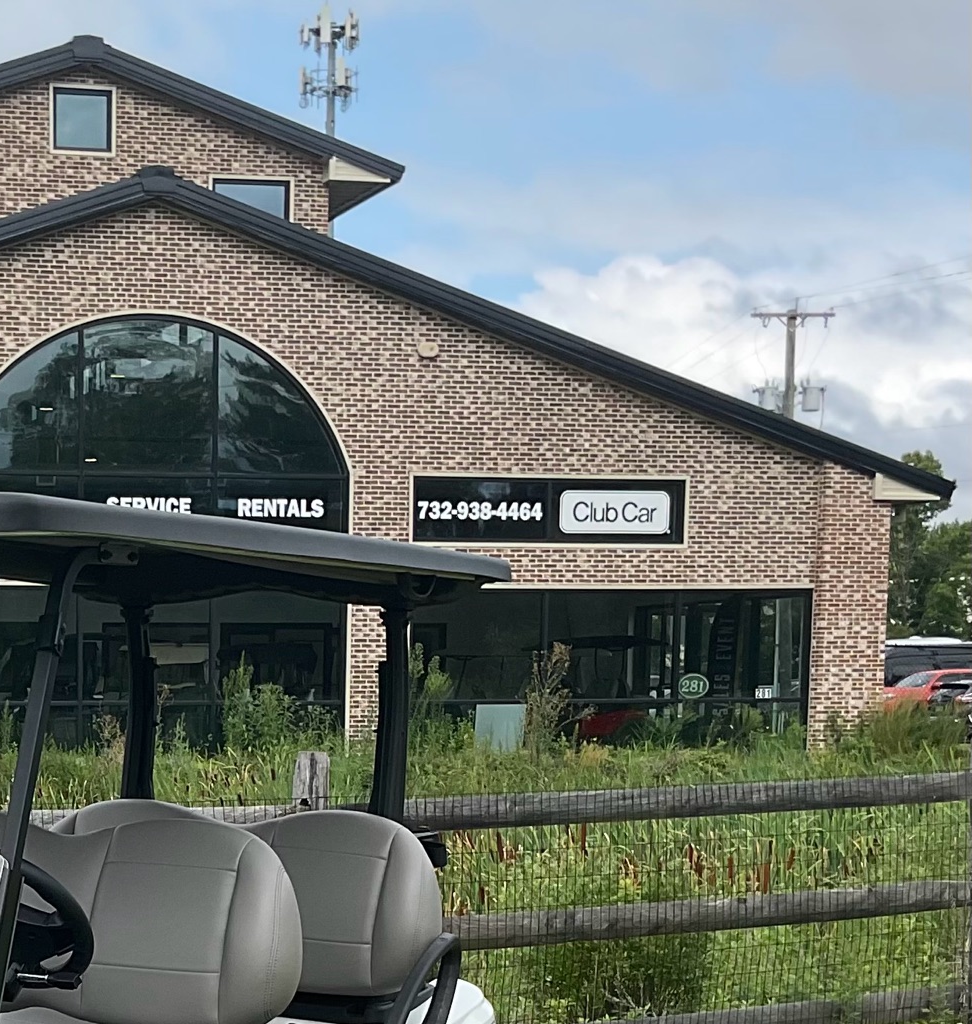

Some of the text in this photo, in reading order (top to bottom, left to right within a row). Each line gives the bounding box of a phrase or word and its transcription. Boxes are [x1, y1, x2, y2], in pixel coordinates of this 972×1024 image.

[237, 499, 324, 518] RENTALS
[417, 501, 542, 521] 732-938-4464
[573, 501, 657, 523] Club Car
[681, 680, 704, 693] 281
[756, 689, 771, 699] 281
